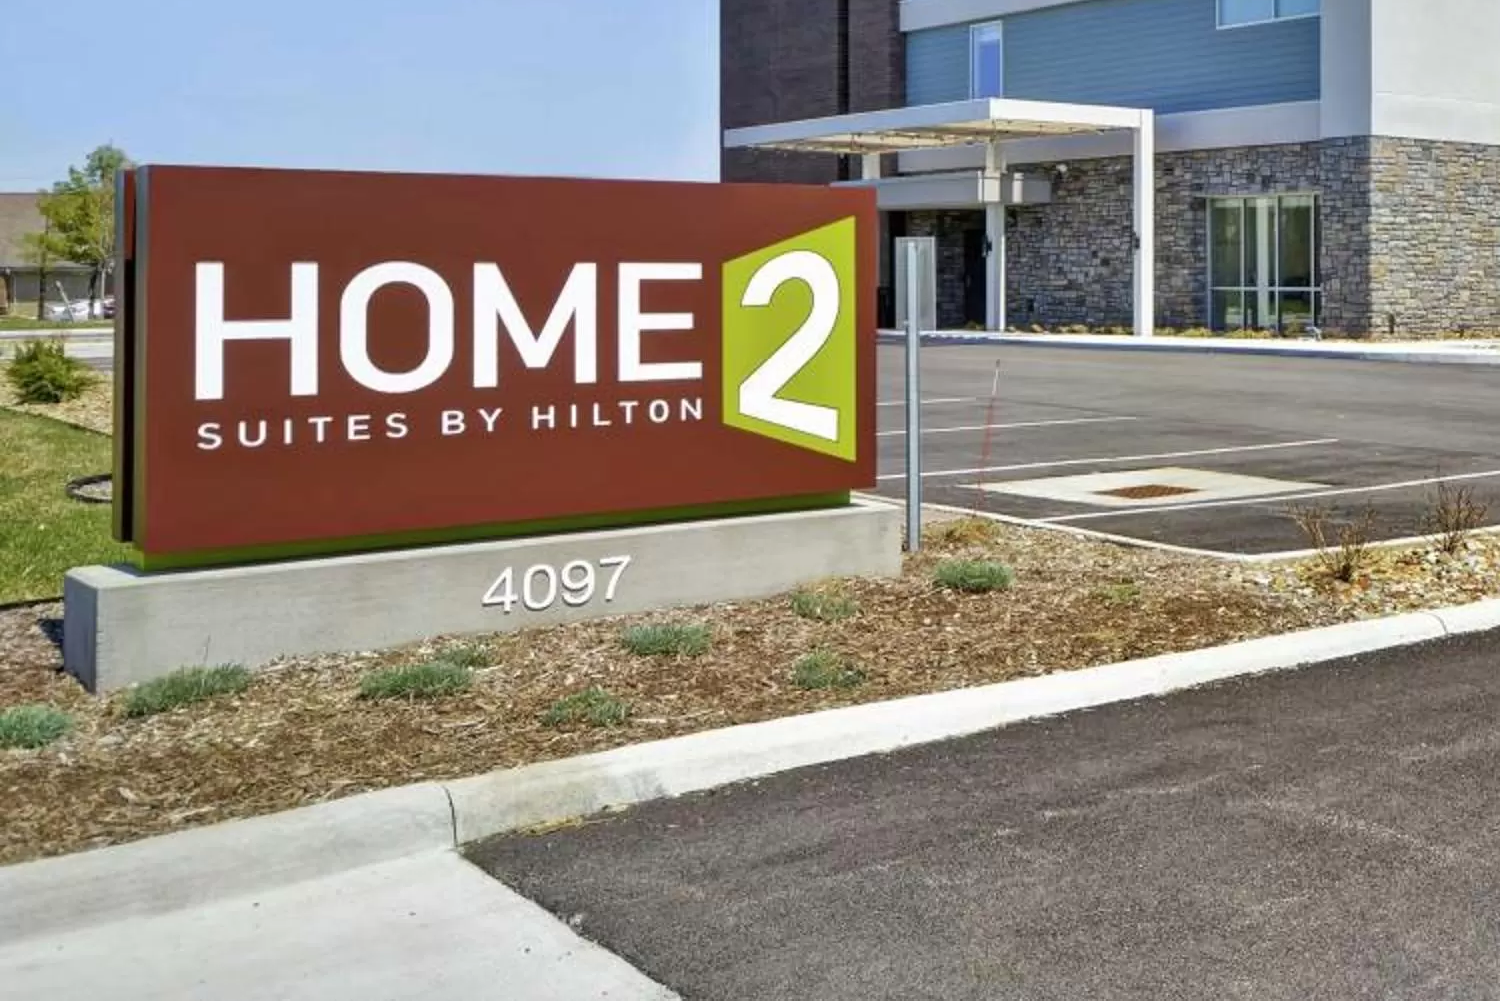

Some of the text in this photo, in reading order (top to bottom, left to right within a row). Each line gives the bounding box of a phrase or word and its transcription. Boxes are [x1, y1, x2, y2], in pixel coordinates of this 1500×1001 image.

[195, 250, 842, 443] HOME 2
[197, 398, 704, 450] SUITES BY HILTON
[481, 554, 633, 612] 4097
